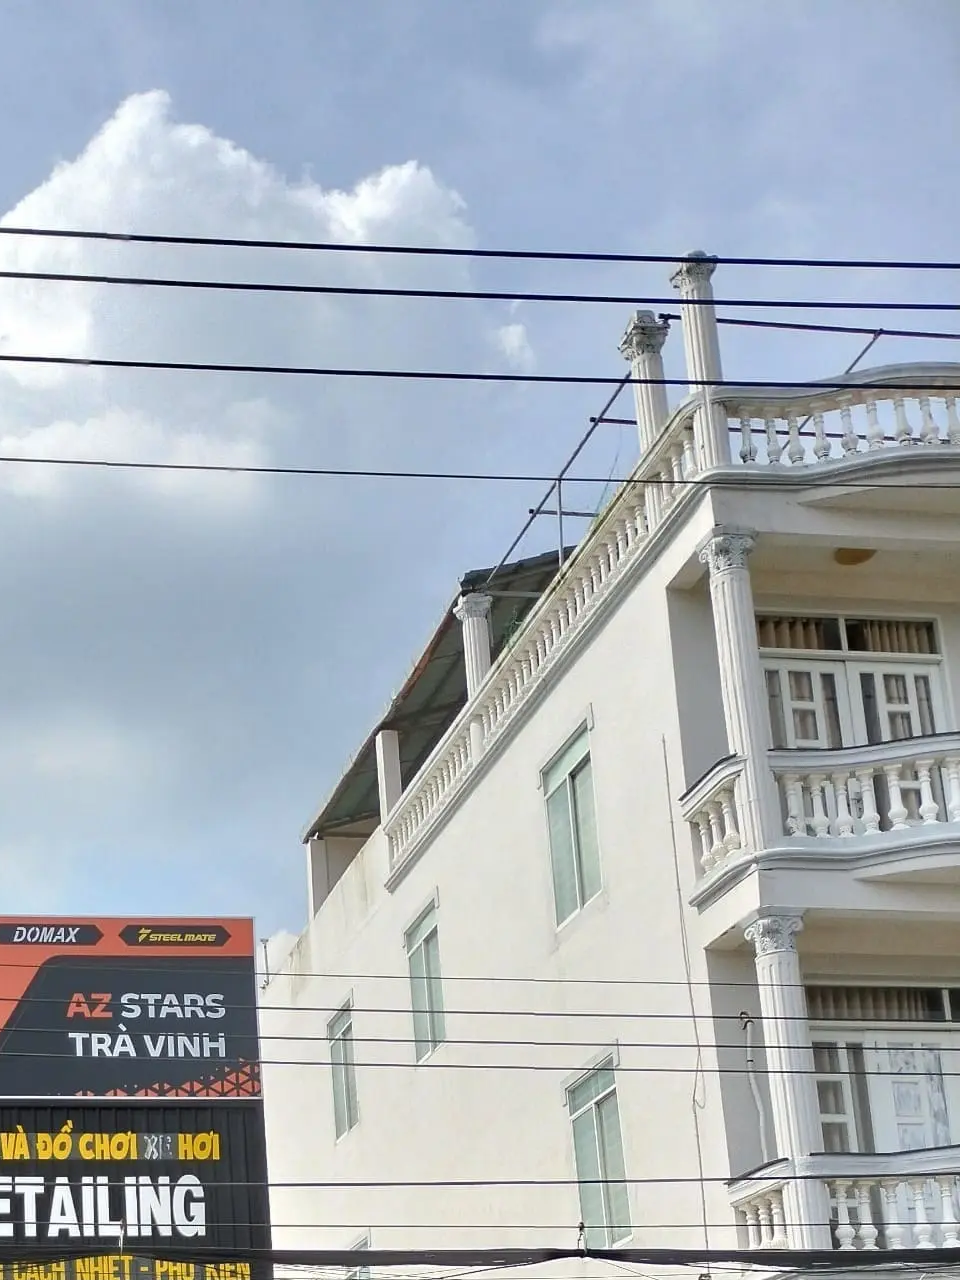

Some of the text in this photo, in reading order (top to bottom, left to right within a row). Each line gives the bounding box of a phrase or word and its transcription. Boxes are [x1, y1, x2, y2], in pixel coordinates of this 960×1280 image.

[13, 926, 80, 943] DOMAX
[66, 992, 227, 1020] AZ STARS
[68, 1023, 227, 1058] TRÀ VINH
[0, 1125, 30, 1160] VÀ
[36, 1119, 73, 1160] ĐỒ
[78, 1130, 138, 1161] CHƠI
[178, 1130, 221, 1161] HƠI
